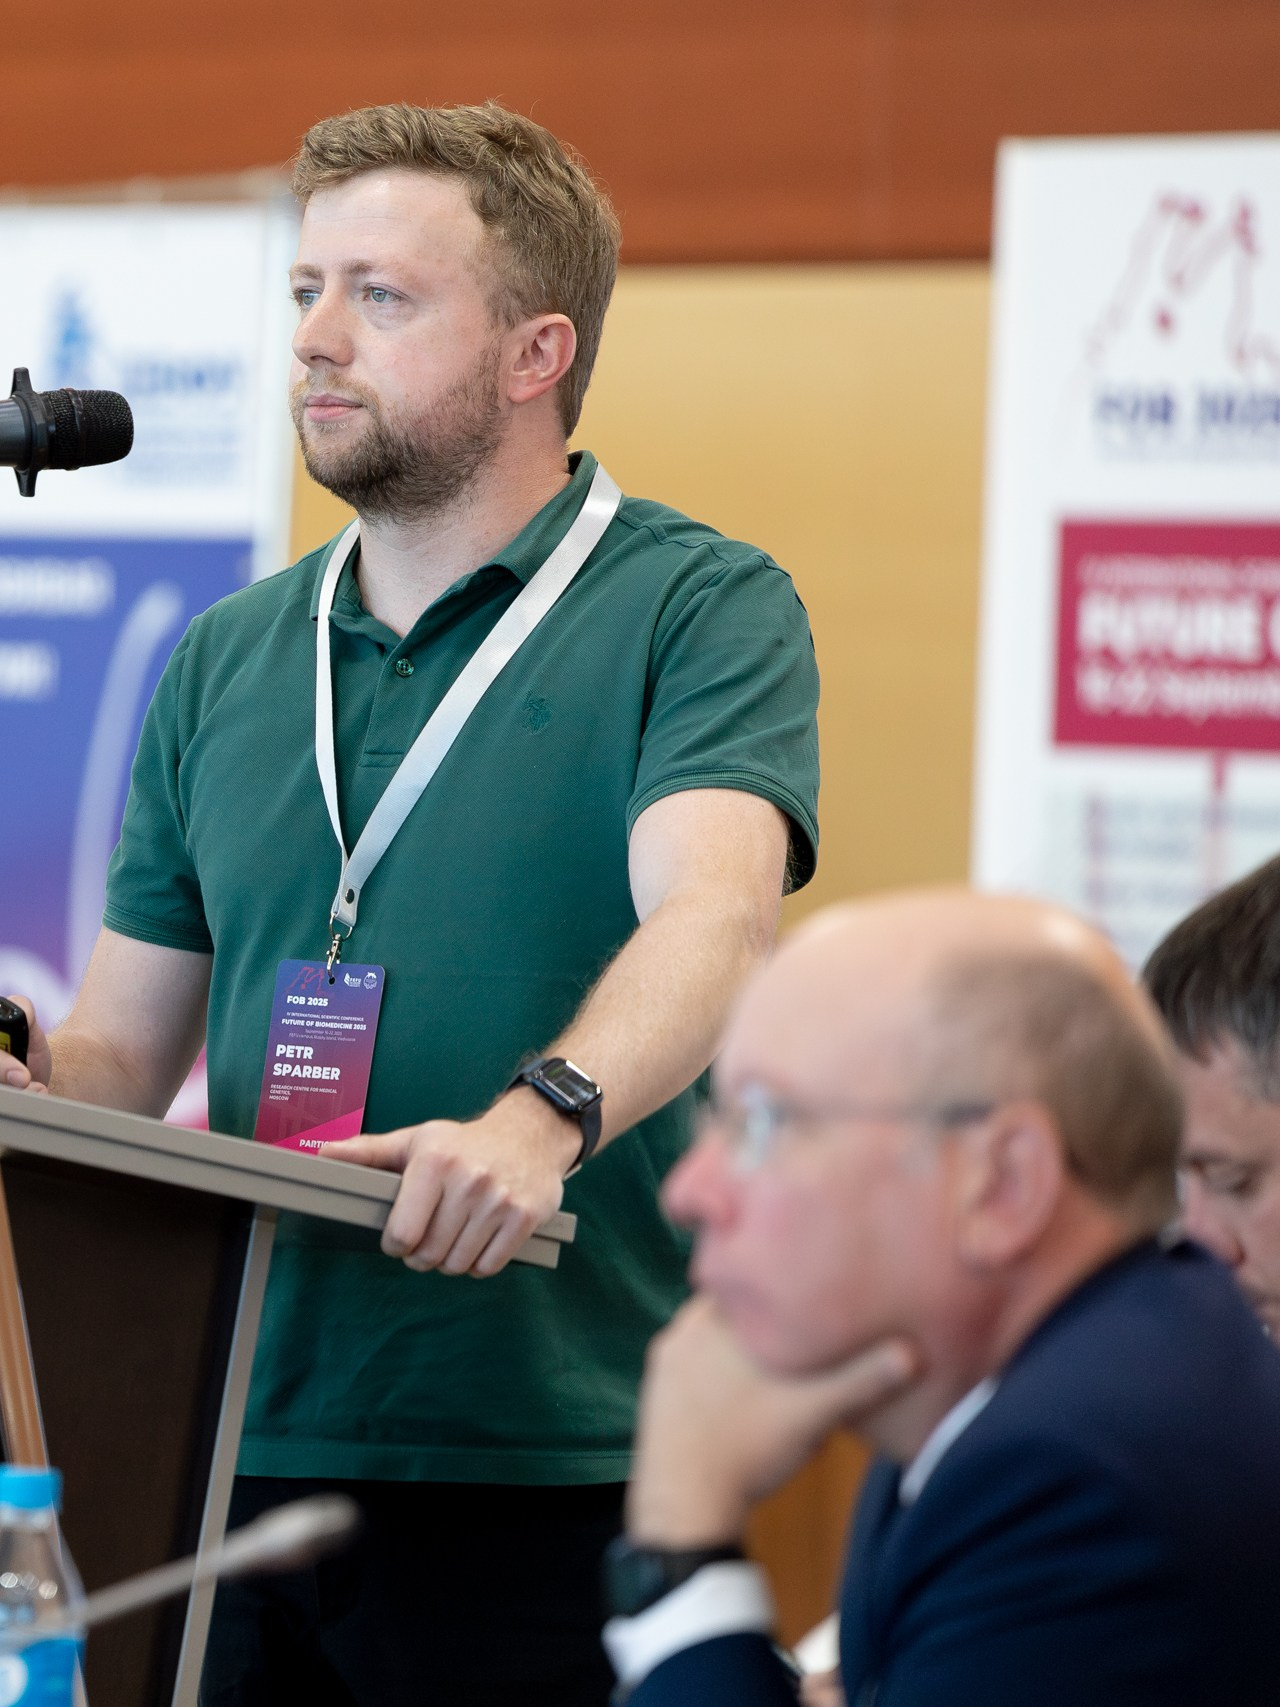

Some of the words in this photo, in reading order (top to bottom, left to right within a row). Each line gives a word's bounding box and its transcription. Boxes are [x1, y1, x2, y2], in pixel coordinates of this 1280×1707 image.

[1076, 595, 1261, 664] FUTURE
[286, 996, 306, 1004] FOB
[308, 998, 328, 1006] 2025
[276, 1044, 314, 1060] PETR
[272, 1064, 340, 1080] SPARBER
